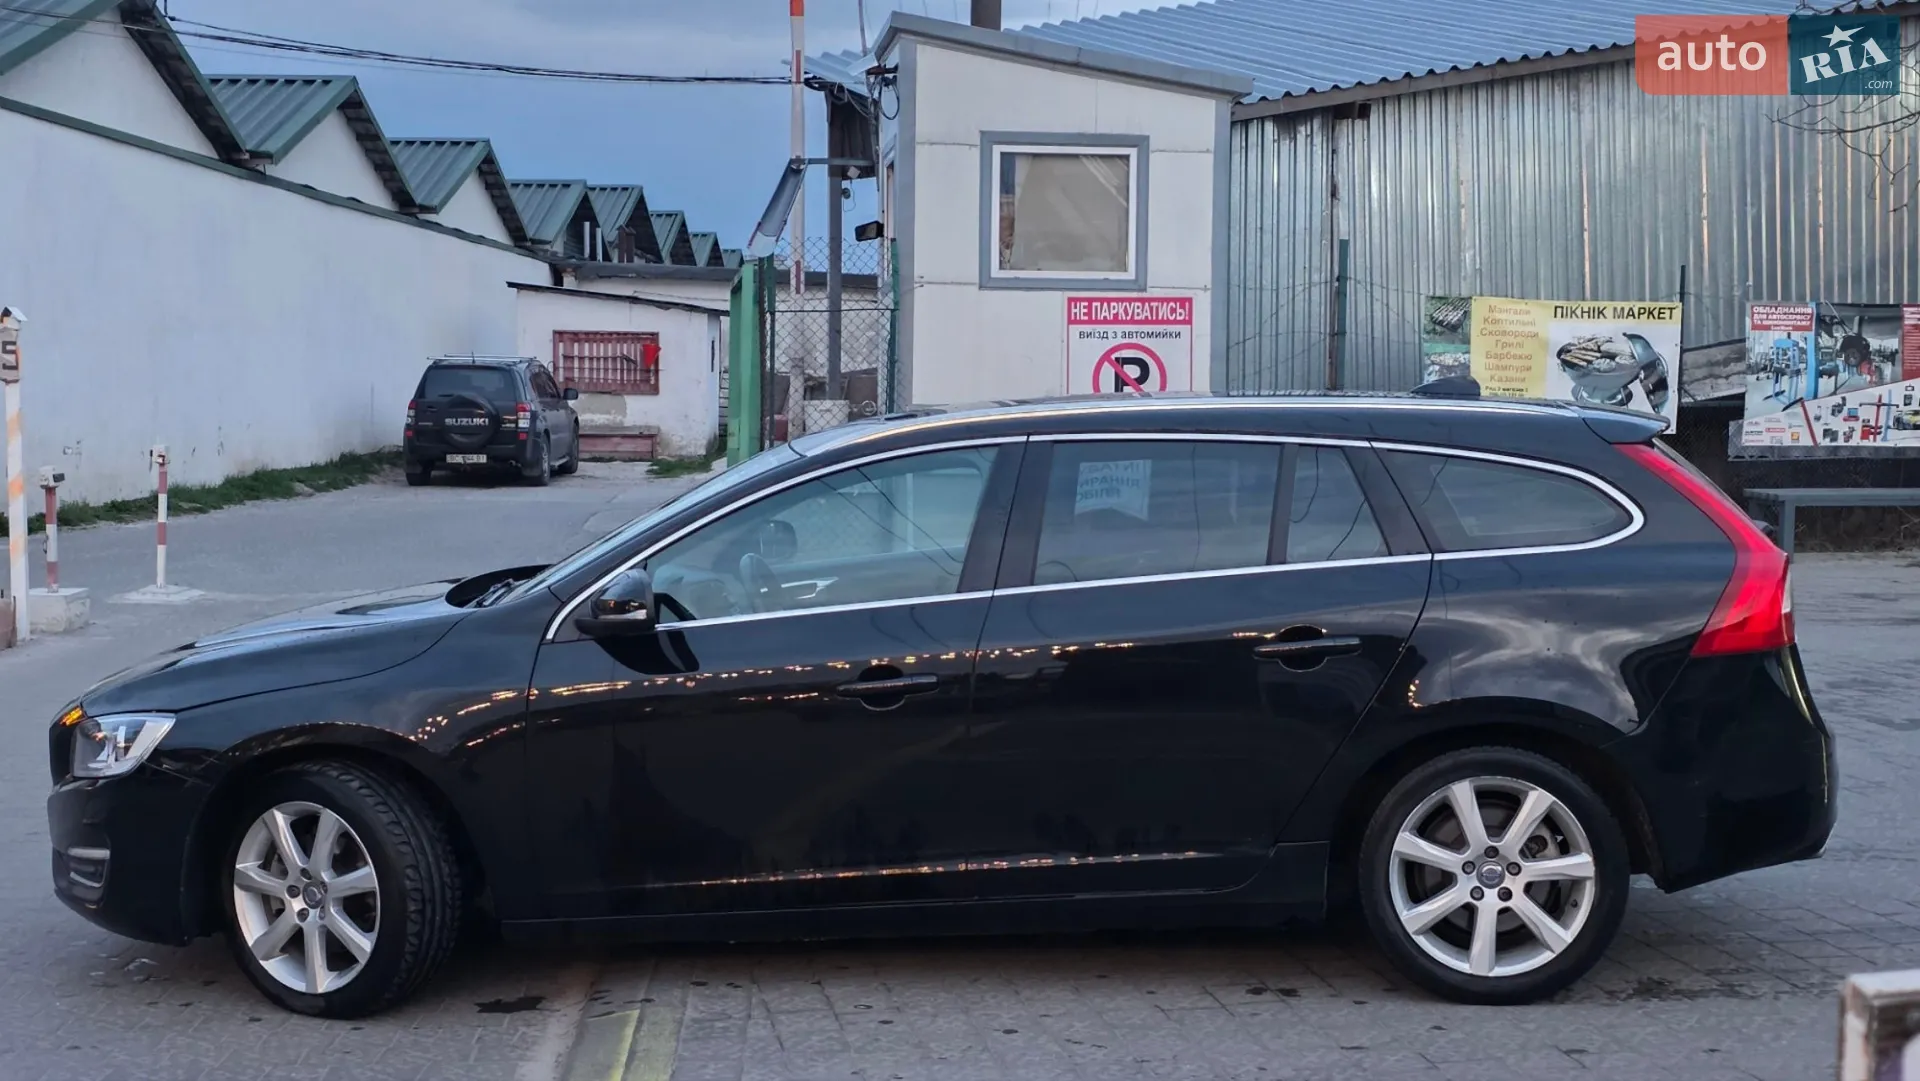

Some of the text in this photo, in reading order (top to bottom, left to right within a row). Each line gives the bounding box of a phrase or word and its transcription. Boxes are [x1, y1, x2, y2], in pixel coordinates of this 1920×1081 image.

[1071, 301, 1190, 321] НЕ ПАРКУВАТИСЬ!
[1488, 304, 1531, 316] Мангали
[1553, 305, 1676, 320] ПІКНІК МАРКЕТ
[1753, 306, 1812, 314] ОБЛАДНАННЯ
[1483, 316, 1536, 327] Коптильні
[1079, 328, 1182, 340] виїзд з автомийки
[1480, 327, 1539, 339] Сковороди
[1495, 340, 1525, 350] Грилі
[1485, 351, 1533, 361] Барбекю
[1485, 362, 1532, 373] Шампури
[1490, 374, 1526, 383] Казани
[444, 417, 489, 426] SUZUKI
